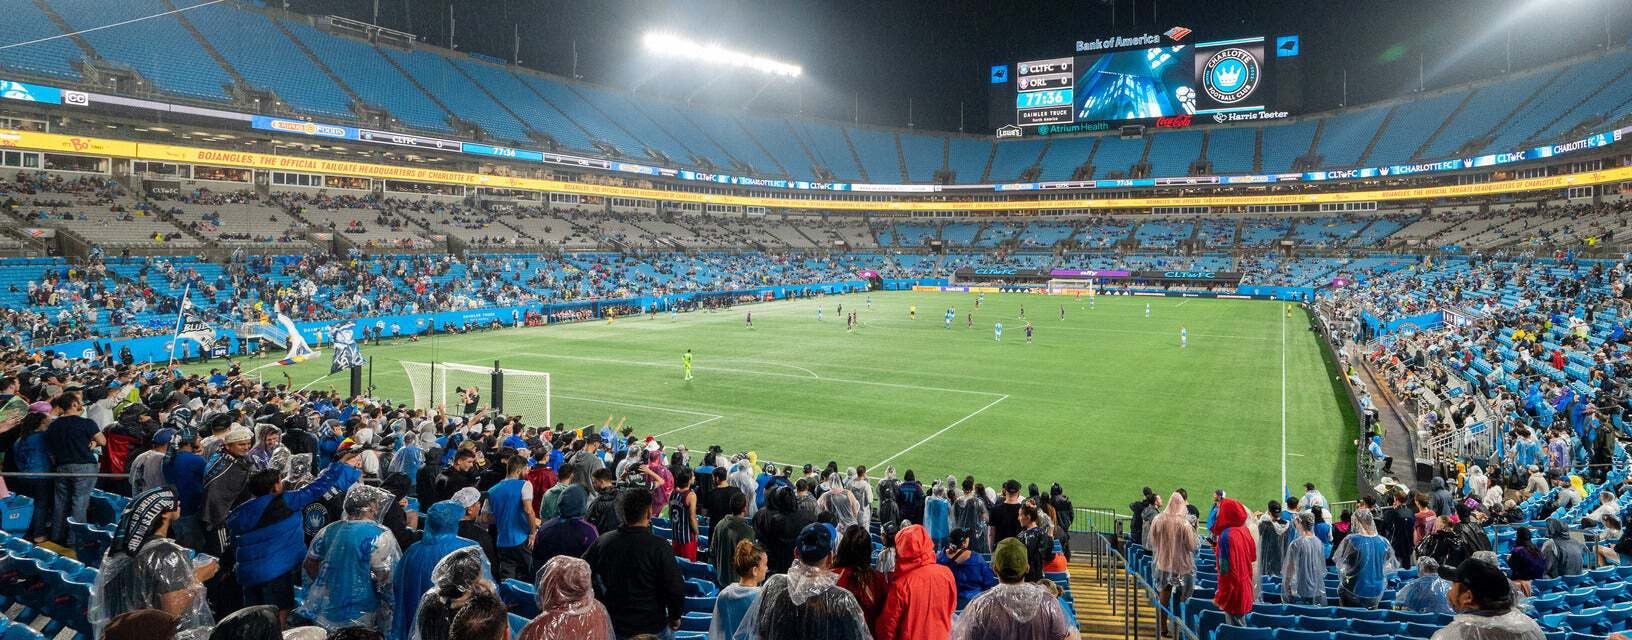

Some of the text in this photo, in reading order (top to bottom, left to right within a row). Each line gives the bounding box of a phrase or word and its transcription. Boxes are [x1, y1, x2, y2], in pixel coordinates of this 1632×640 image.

[1076, 33, 1160, 52] Bank of America
[1208, 50, 1252, 68] CHARLOTTE
[1030, 62, 1067, 73] CLTFC 0
[1030, 76, 1067, 87] ORL 0
[67, 93, 86, 103] CC
[1026, 91, 1063, 106] 77:36
[1208, 84, 1251, 100] FOOTBALL CLUB
[1228, 110, 1288, 121] Harris Teeter
[1050, 122, 1109, 132] Atrium Health
[392, 135, 417, 145] CLTFC
[1554, 137, 1596, 153] CHARLOTTE FC
[260, 156, 277, 166] THE
[280, 158, 317, 169] OFFICIAL
[321, 161, 358, 172] TAILGATE
[359, 164, 415, 177] HEADQUARTERS
[417, 169, 426, 177] OF
[428, 171, 465, 181] CHARLOTTE
[1400, 161, 1453, 174] CHARLOTTE FC
[128, 534, 143, 552] FIRE
